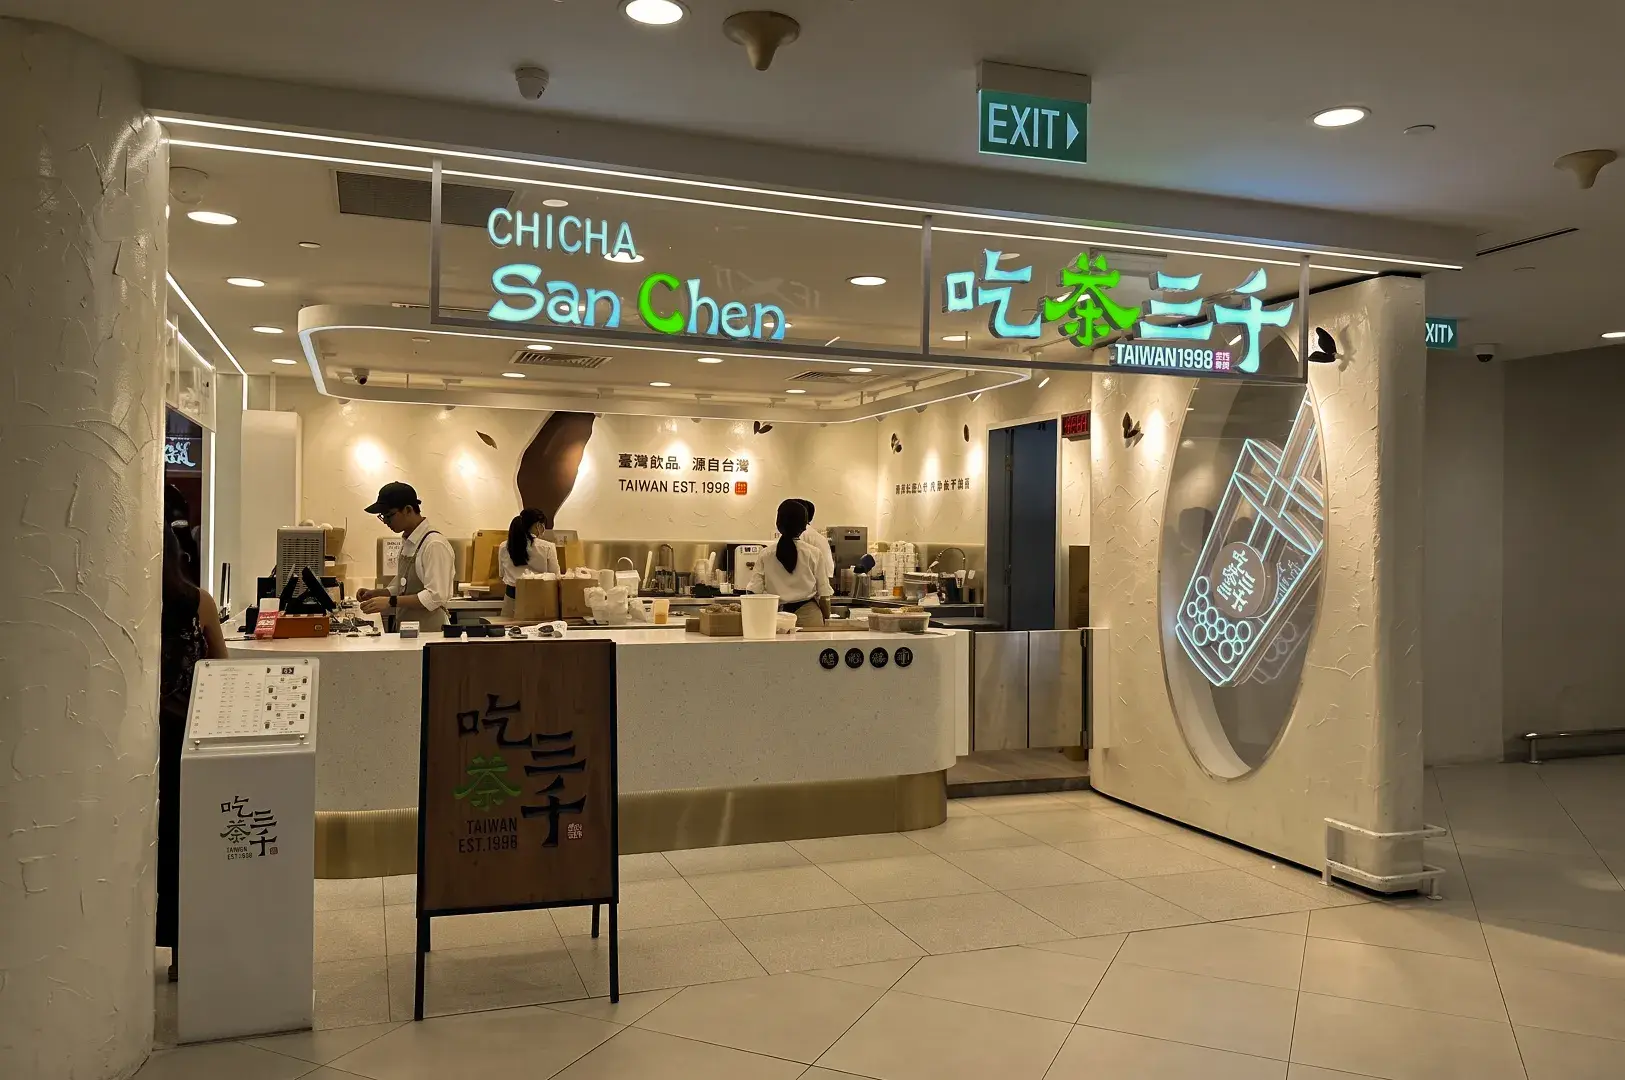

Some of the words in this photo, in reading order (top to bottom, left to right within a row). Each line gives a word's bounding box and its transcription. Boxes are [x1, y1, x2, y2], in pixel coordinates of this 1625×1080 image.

[988, 102, 1060, 149] EXIT
[487, 207, 638, 260] CHICHA
[488, 263, 622, 329] San
[636, 272, 786, 342] Chen
[942, 248, 1294, 373] 吃茶三千
[1425, 322, 1448, 343] XIT
[618, 479, 668, 493] TAIWAN
[672, 481, 698, 494] EST.
[702, 482, 730, 494] 1998
[466, 817, 518, 835] TAIWAN
